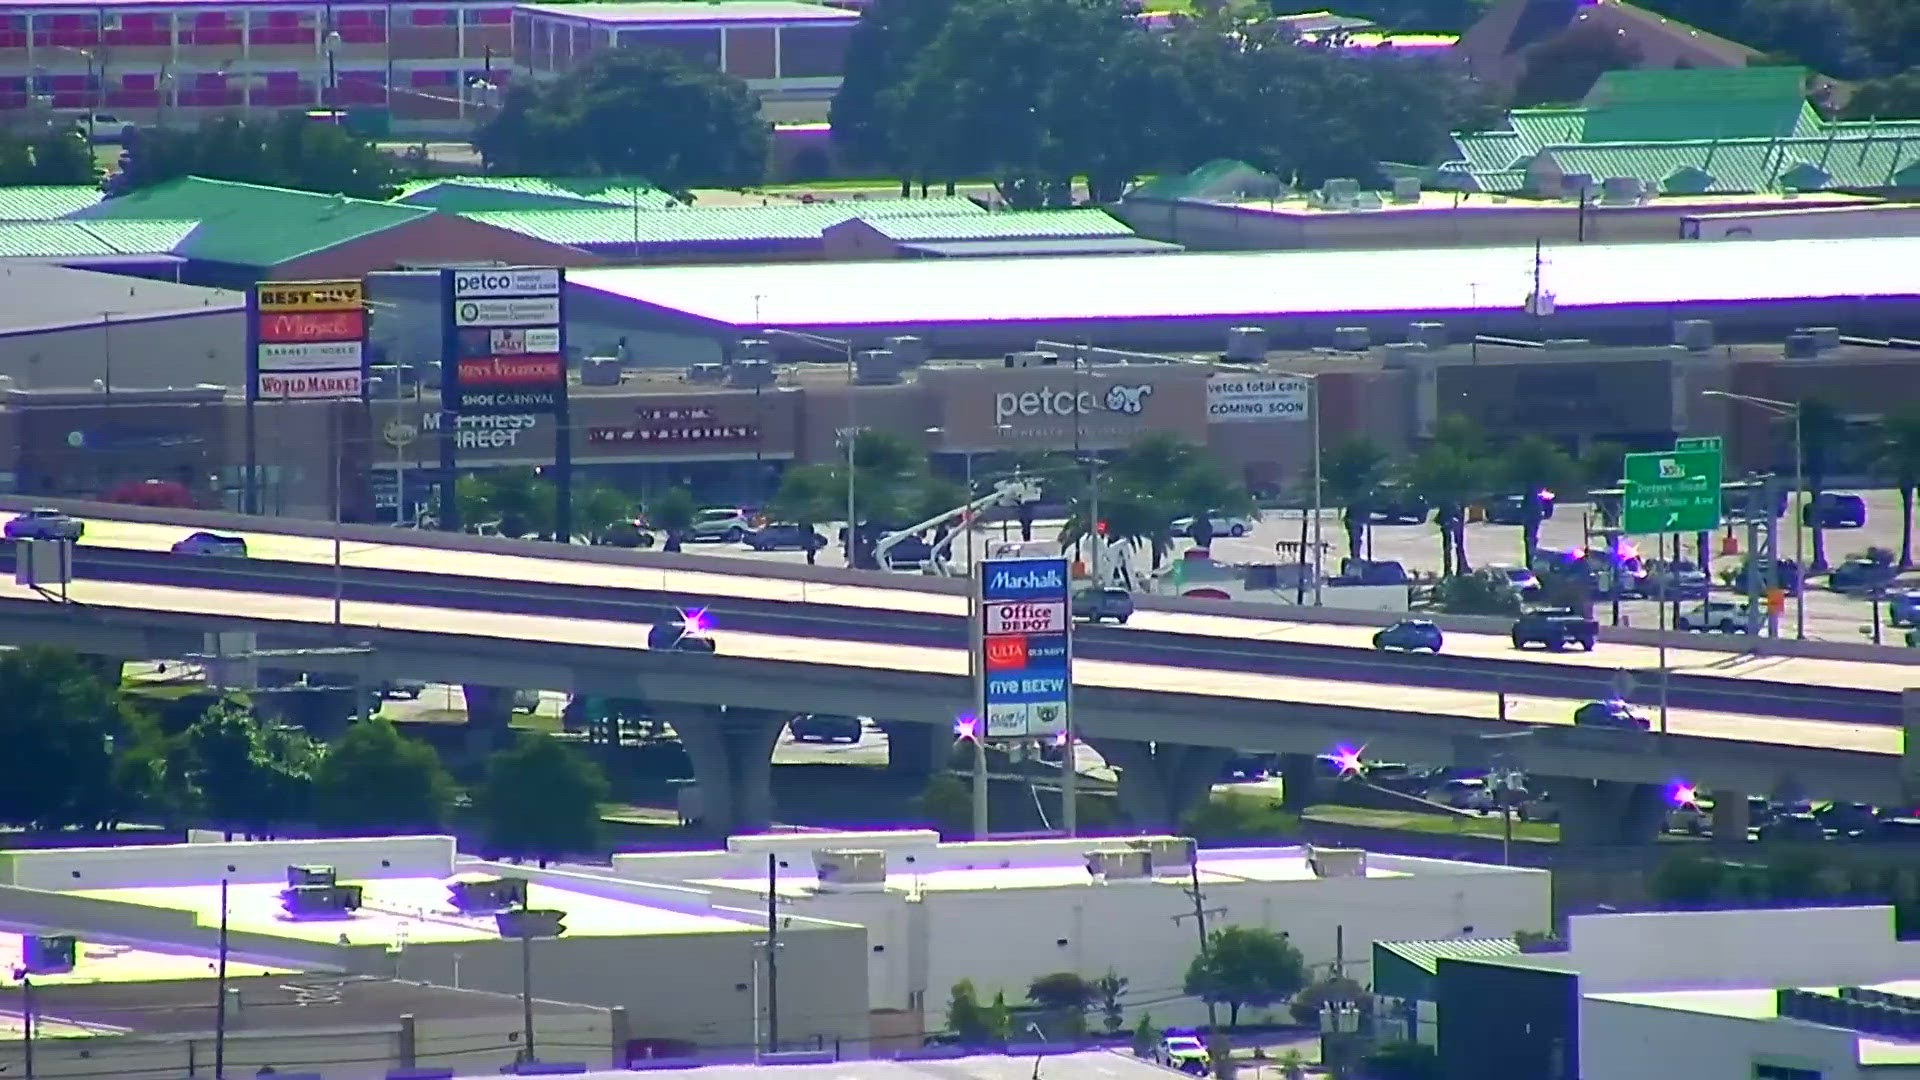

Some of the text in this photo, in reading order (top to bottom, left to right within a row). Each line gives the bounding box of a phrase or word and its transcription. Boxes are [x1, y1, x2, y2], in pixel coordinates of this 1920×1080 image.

[457, 273, 511, 294] petco
[261, 290, 310, 304] BEST
[261, 375, 359, 393] WORLD MARKET
[1208, 382, 1243, 393] vetco
[1247, 381, 1275, 391] total
[462, 392, 554, 405] SHOE CARNIVAL
[1210, 401, 1304, 414] COMING SOON
[423, 412, 535, 431] MTTRESS
[990, 569, 1063, 589] Marshalls
[1000, 605, 1051, 619] Office
[1002, 620, 1050, 630] DEPOT
[990, 645, 1023, 660] ULTA
[989, 681, 1019, 694] five
